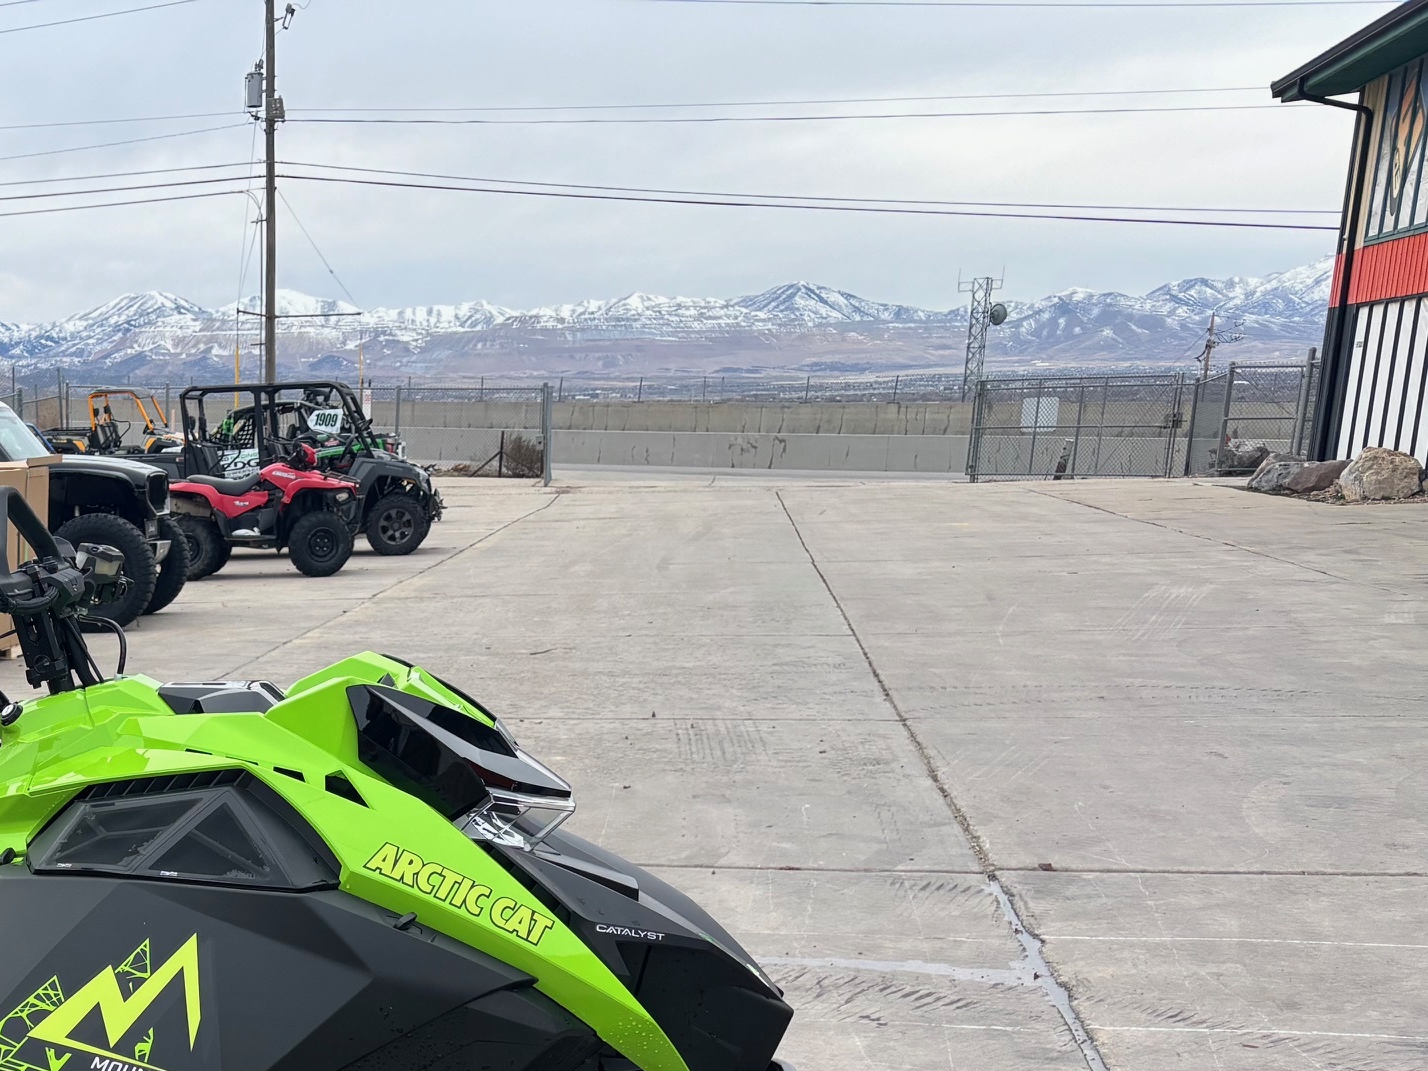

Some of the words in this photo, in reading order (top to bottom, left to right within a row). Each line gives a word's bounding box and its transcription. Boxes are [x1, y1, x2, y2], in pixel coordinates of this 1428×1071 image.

[314, 412, 338, 428] 1909
[363, 841, 493, 918] ARCTIC
[489, 896, 556, 947] CAT
[595, 924, 666, 941] CATALYST
